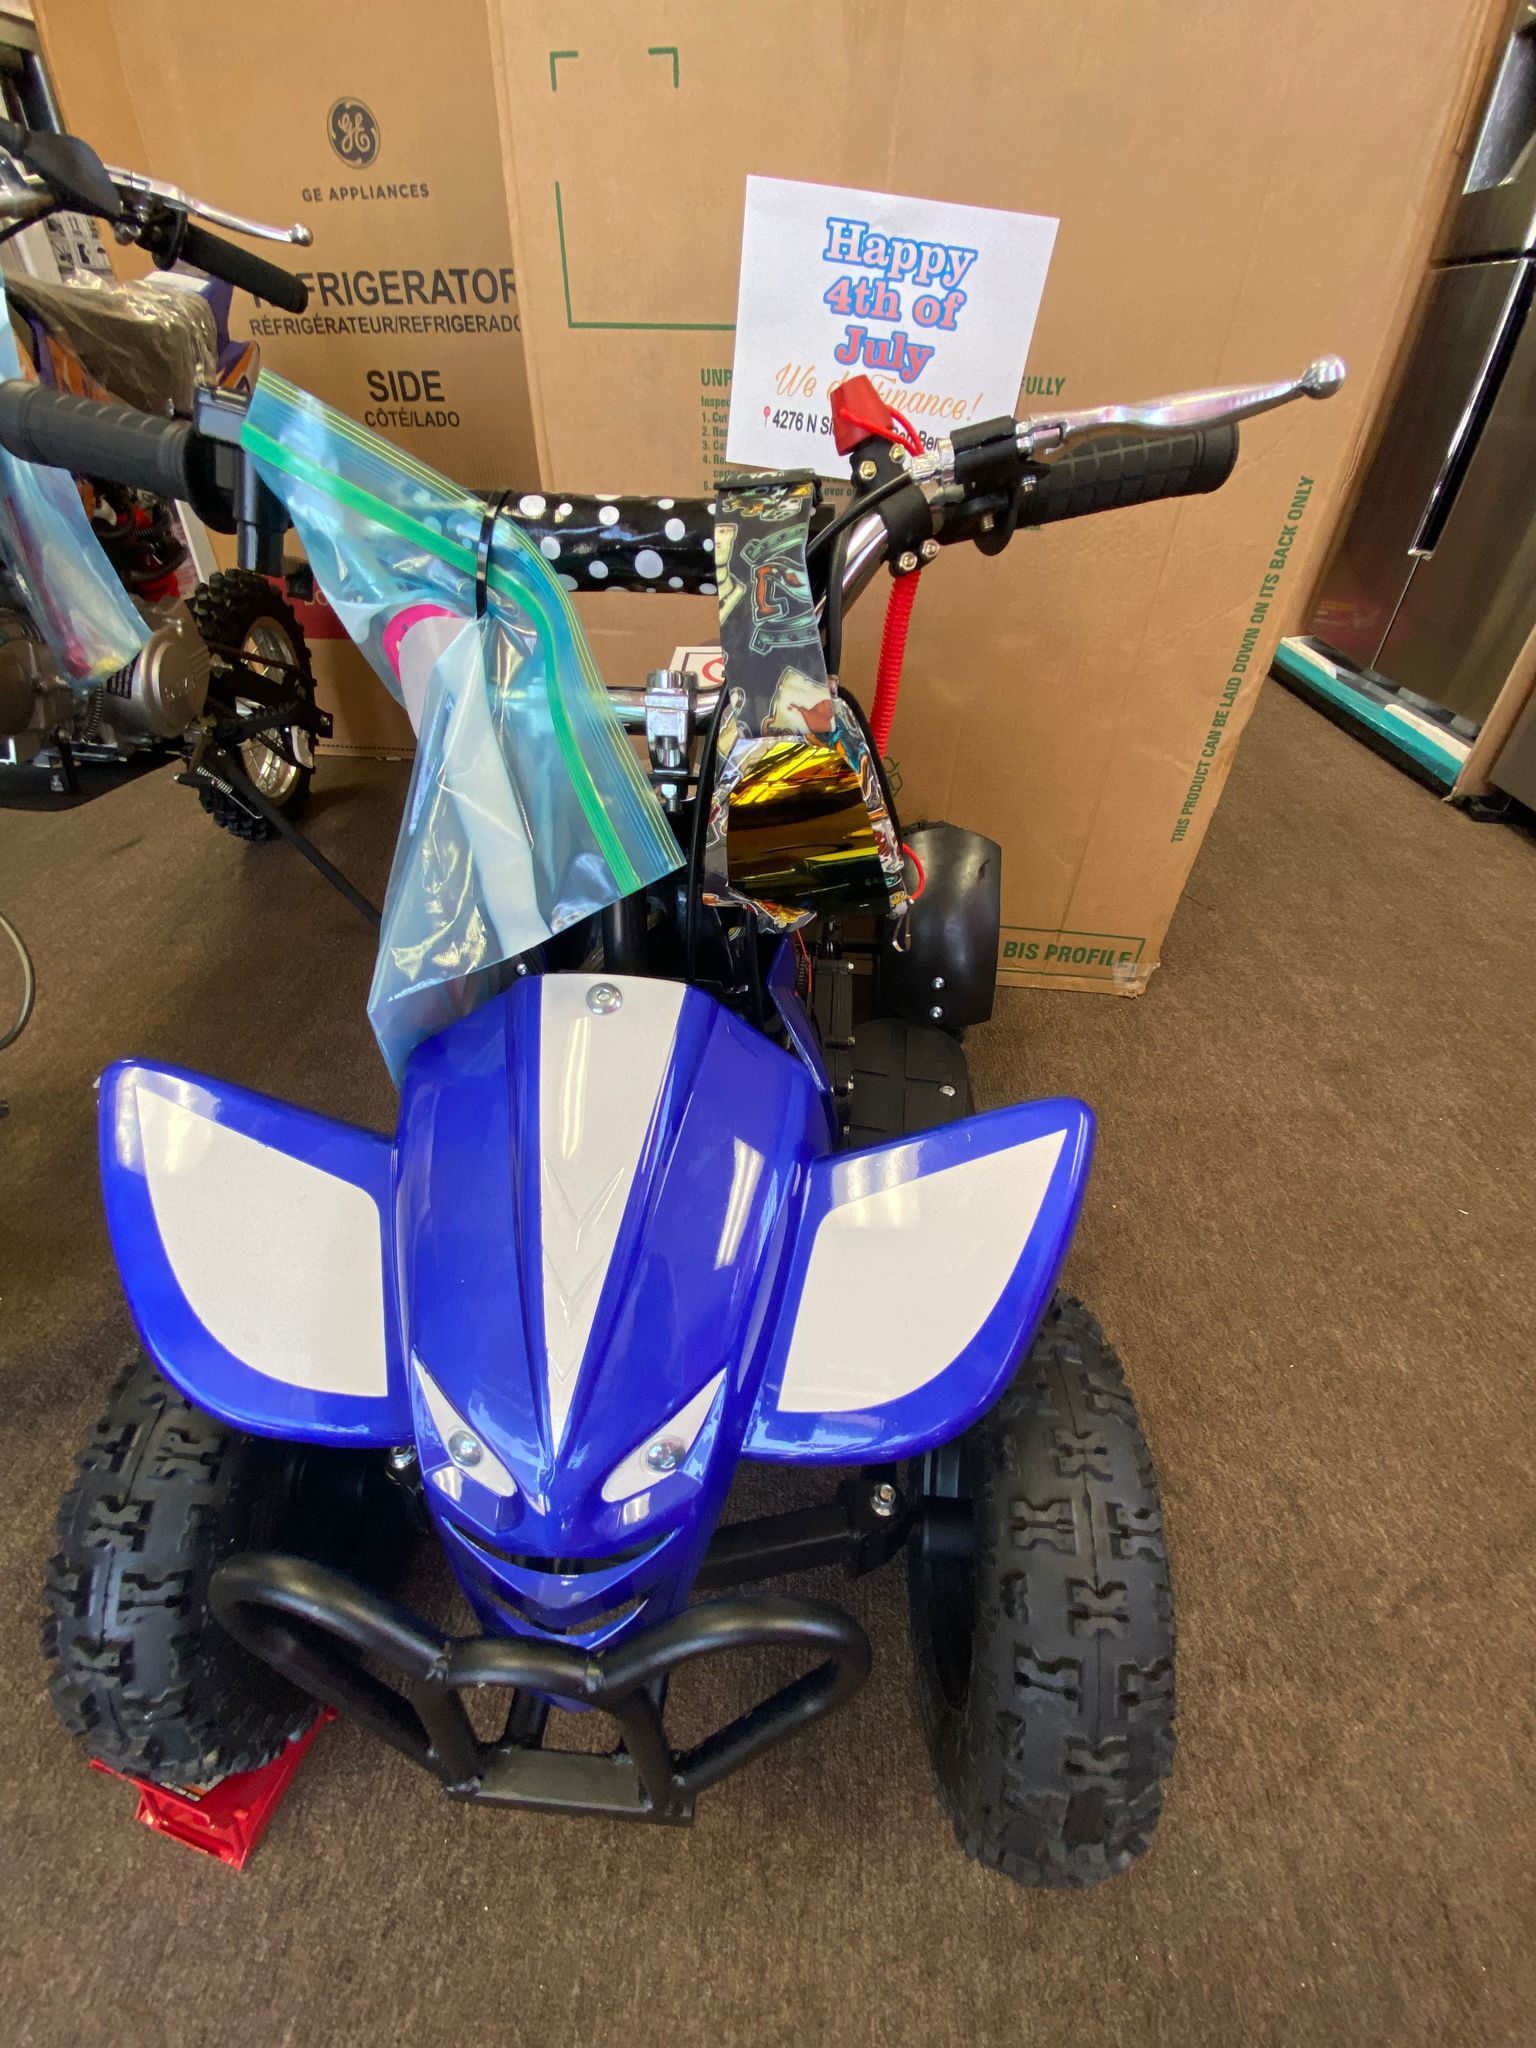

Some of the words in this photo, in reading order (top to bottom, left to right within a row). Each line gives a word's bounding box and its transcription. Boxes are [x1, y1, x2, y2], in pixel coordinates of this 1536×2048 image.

[302, 187, 323, 202] GE
[329, 183, 430, 201] APPLIANCES
[823, 216, 978, 287] Happy
[823, 276, 901, 322] 4th
[912, 290, 967, 331] of
[834, 324, 935, 384] July
[366, 370, 445, 402] SIDE
[776, 362, 817, 398] We
[364, 407, 460, 428] CÔTÉ/LADO
[773, 409, 803, 431] 4276
[807, 415, 817, 433] N
[1287, 475, 1314, 521] ONLY
[1269, 524, 1299, 570] BACK
[1260, 573, 1280, 598] ITS
[1251, 602, 1270, 624] ON
[1232, 628, 1260, 673] DOWN
[1219, 677, 1242, 707] LAID
[1212, 710, 1229, 727] BE
[1202, 729, 1222, 758] CAN
[1181, 760, 1211, 816] PRODUCT
[1171, 817, 1190, 844] THIS
[1003, 941, 1040, 961] BIS
[1044, 943, 1133, 969] PROFILE
